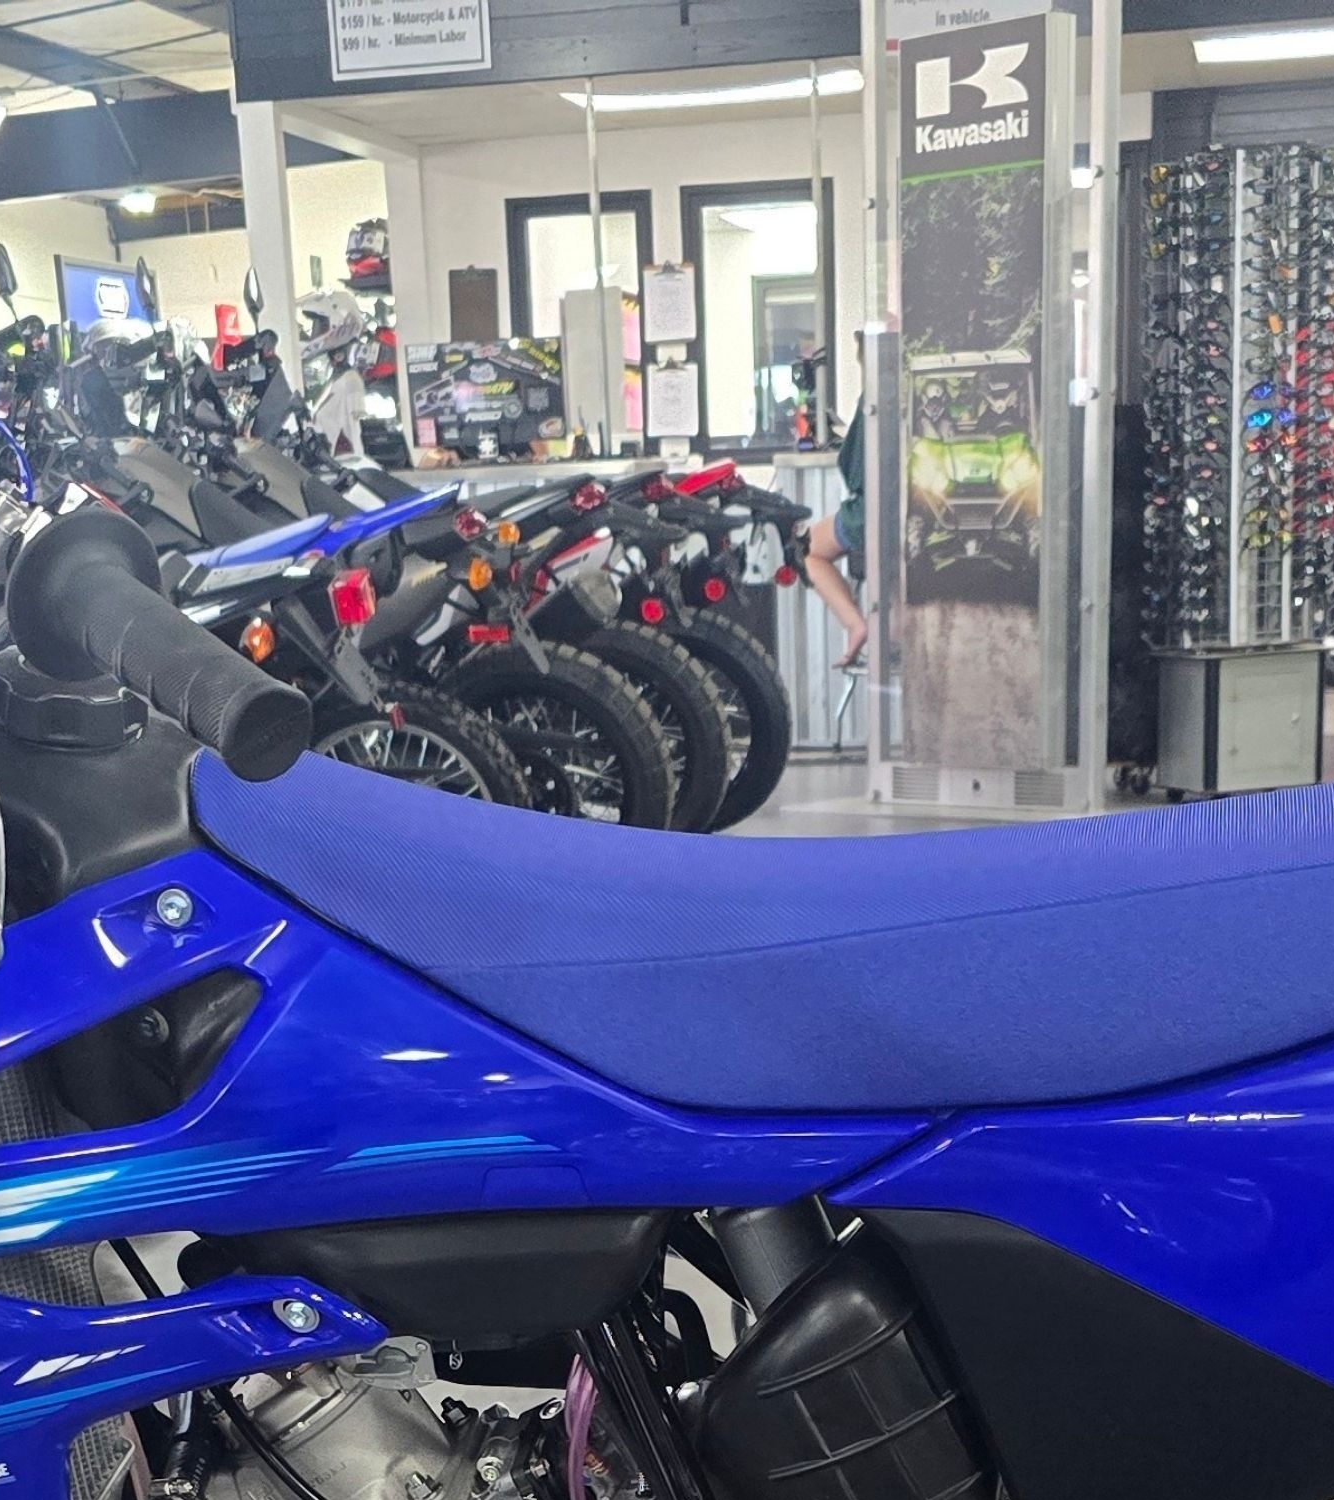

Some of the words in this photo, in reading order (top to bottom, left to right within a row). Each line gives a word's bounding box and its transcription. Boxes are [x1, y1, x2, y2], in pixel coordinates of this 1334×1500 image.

[393, 9, 445, 26] Motorcycle
[458, 6, 477, 19] ATV
[394, 33, 436, 47] Minimum
[439, 31, 467, 43] Labor
[916, 109, 1029, 153] Kawasaki
